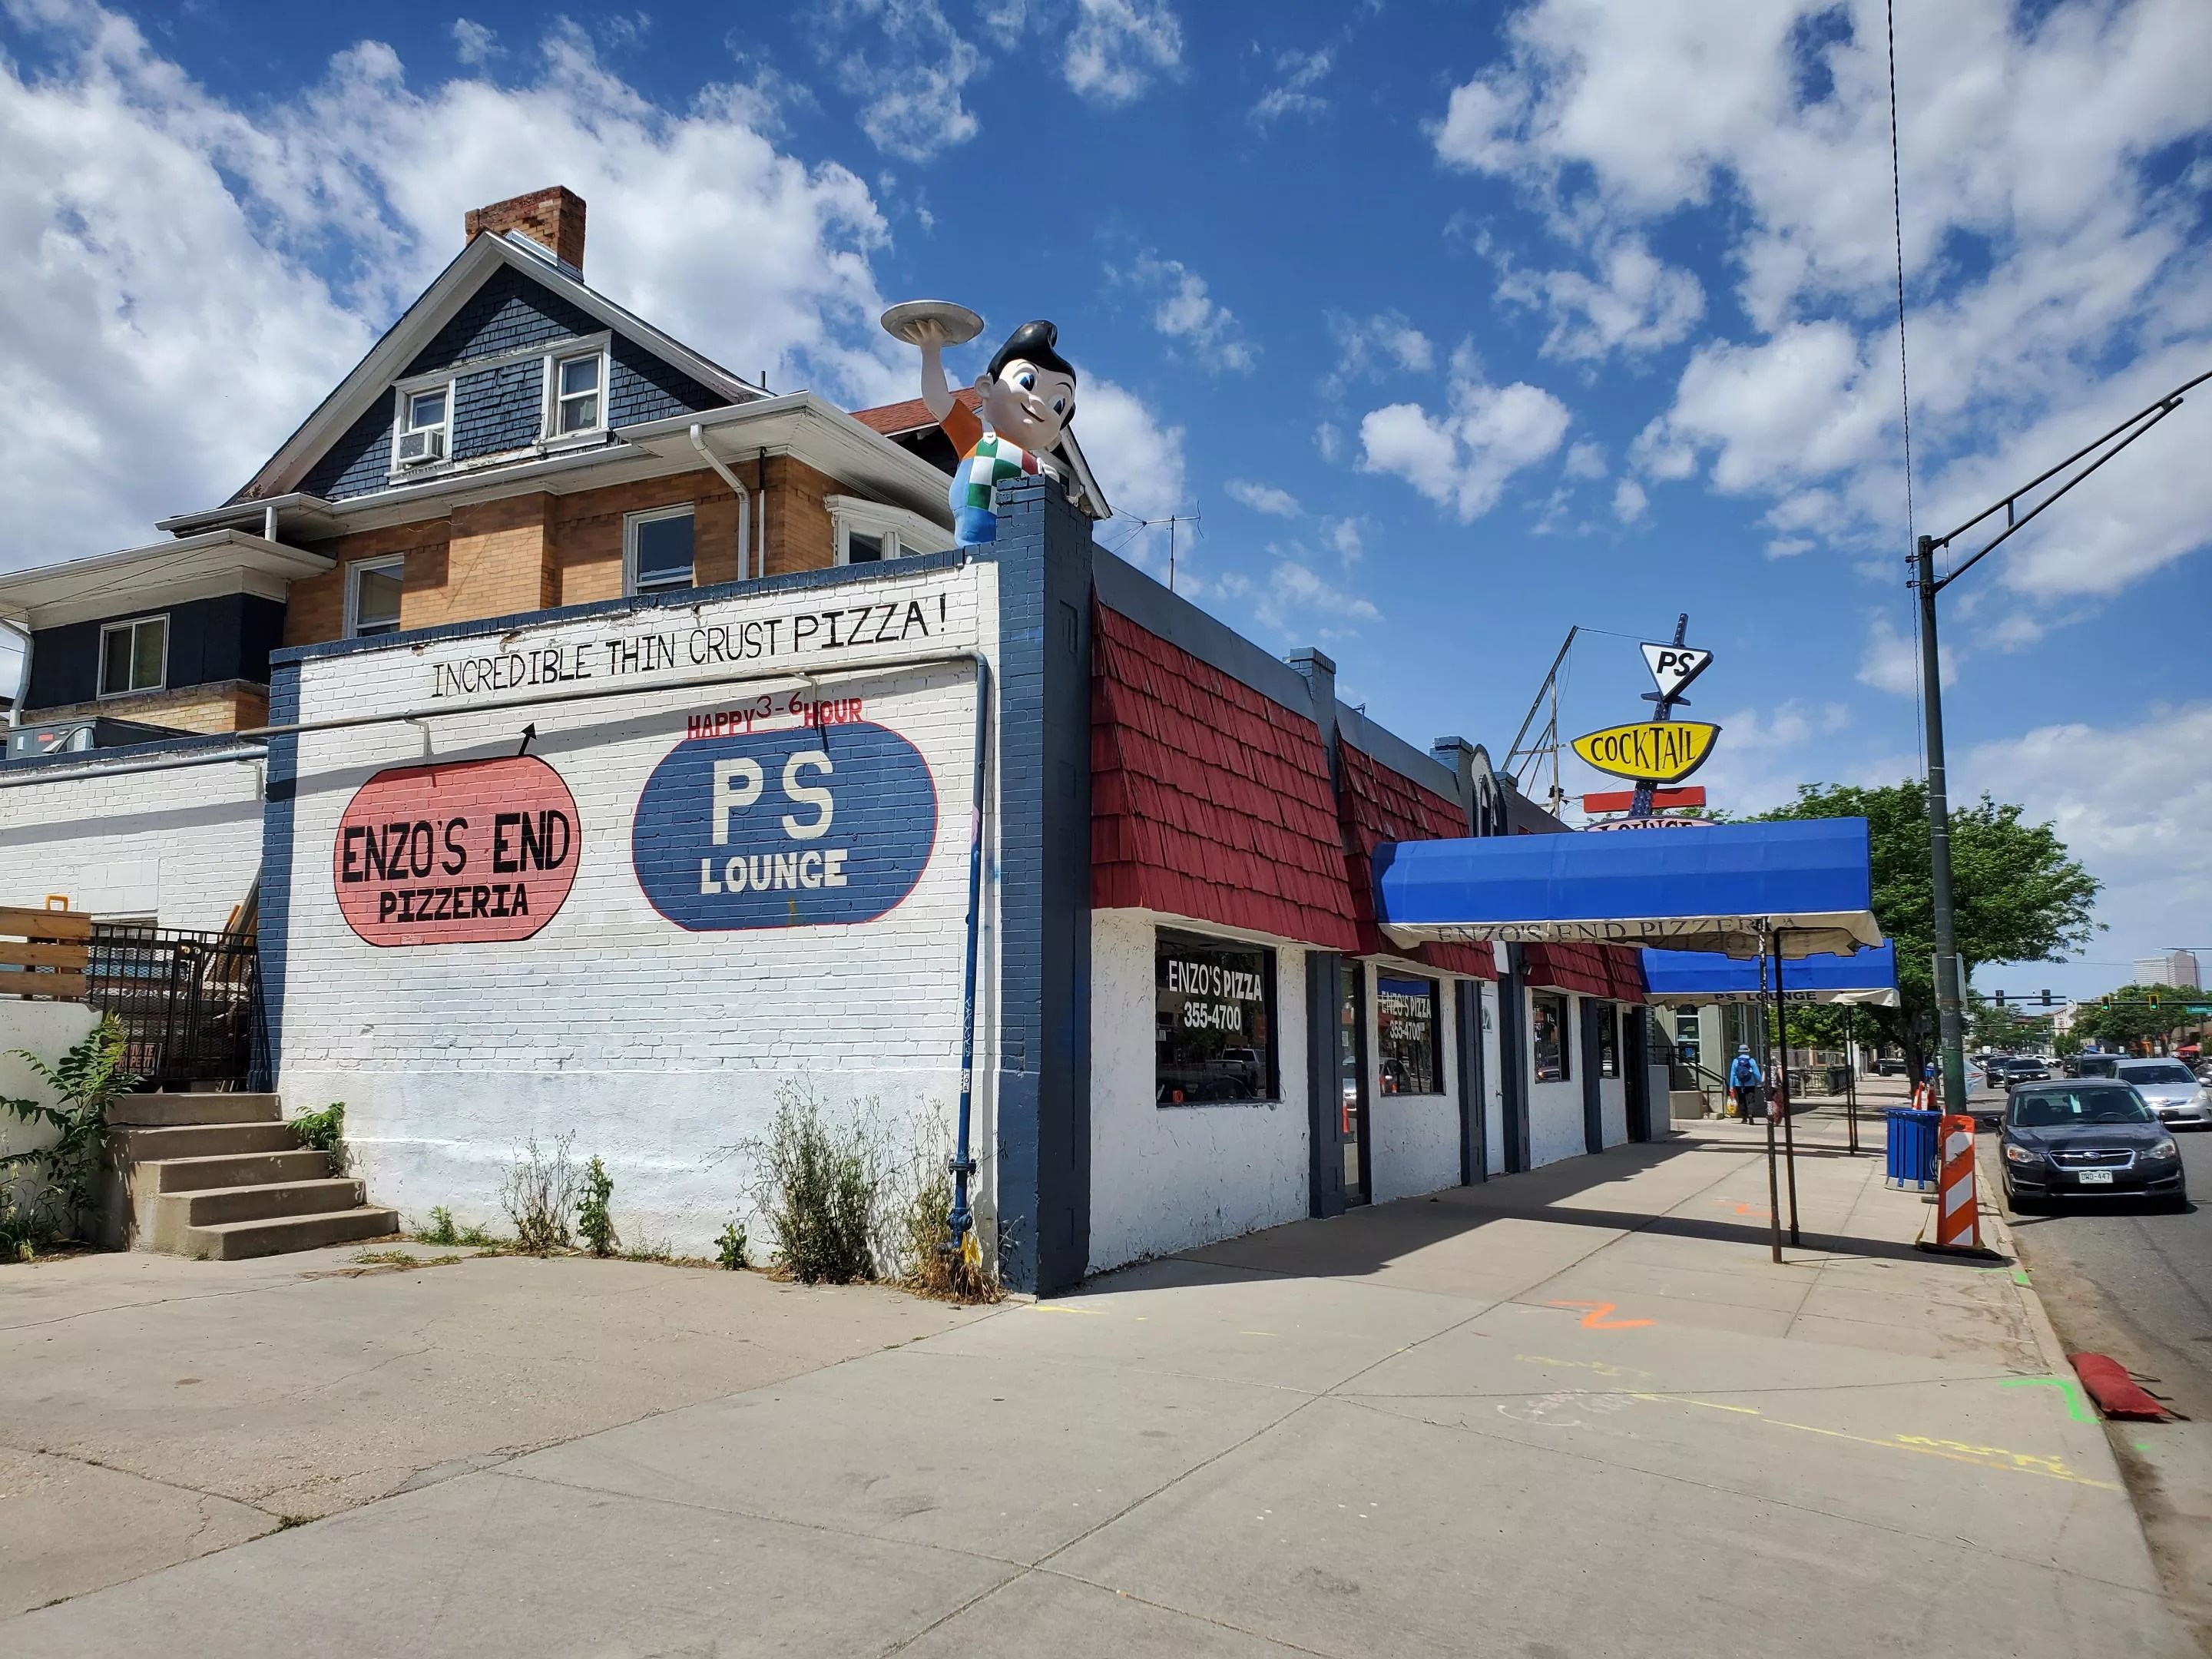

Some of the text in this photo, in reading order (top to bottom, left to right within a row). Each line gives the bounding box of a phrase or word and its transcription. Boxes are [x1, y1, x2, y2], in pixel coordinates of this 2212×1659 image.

[432, 593, 946, 697] INCREDIBLE THIN CRUST PIZZA!
[1657, 651, 1694, 676] PS
[688, 691, 863, 740] HAPPY 3-6 HOUR
[1590, 727, 1696, 771] COCKTAIL
[342, 810, 570, 882] ENZO'S END
[701, 849, 847, 895] LOUNGE
[379, 883, 529, 923] PIZZERIA
[1437, 925, 1547, 942] ENZO'S
[1555, 923, 1627, 942] END
[1169, 960, 1263, 1002] ENZO'S PIZZA
[1714, 993, 1737, 1002] PS
[1184, 1002, 1241, 1031] 355-4700
[1381, 990, 1432, 1018] ENZO'S PIZZA
[1389, 1020, 1420, 1041] 355-4700
